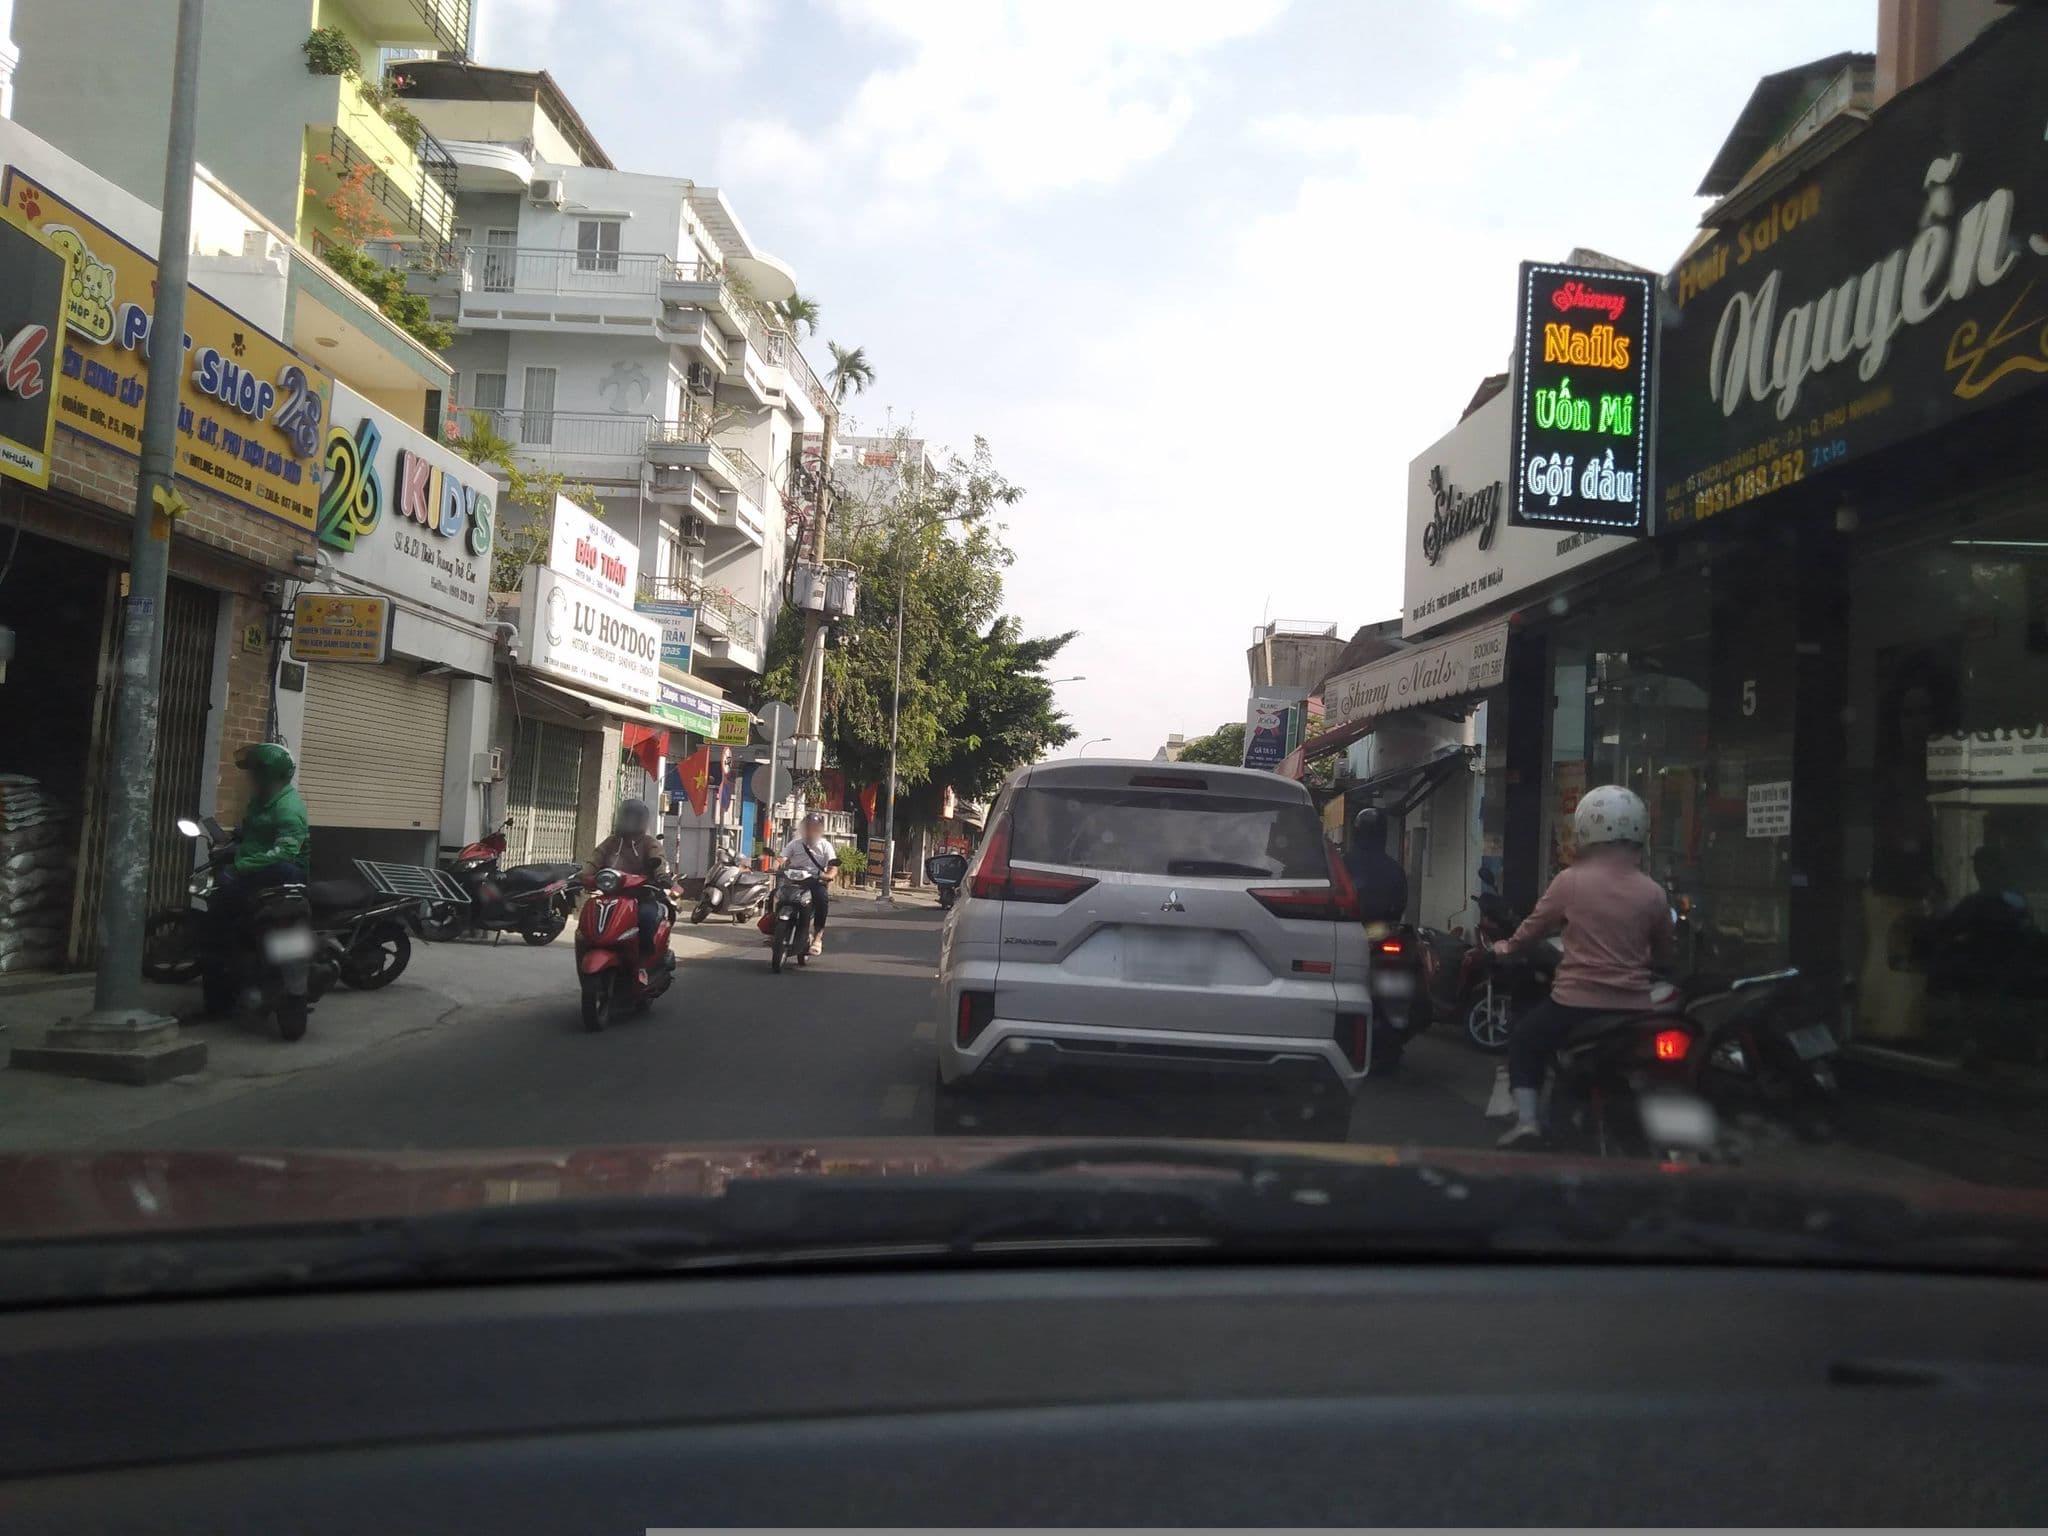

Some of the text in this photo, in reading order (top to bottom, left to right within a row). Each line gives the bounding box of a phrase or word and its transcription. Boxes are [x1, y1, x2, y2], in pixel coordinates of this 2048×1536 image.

[1737, 183, 1822, 265] Salon
[92, 313, 105, 329] 28
[1552, 281, 1626, 320] Shinny
[1544, 323, 1630, 369] Nails
[199, 347, 276, 421] SHOP
[1536, 377, 1590, 431] Uốn
[1, 448, 34, 469] NHUẬN
[318, 417, 383, 554] 26
[1527, 448, 1634, 506] Gội đầu
[399, 448, 493, 558] KID'S
[404, 536, 410, 554] &
[573, 602, 656, 662] LU HOTDOG
[1341, 682, 1390, 715] Shinny
[1397, 651, 1452, 695] Nails
[1742, 680, 1757, 716] 5
